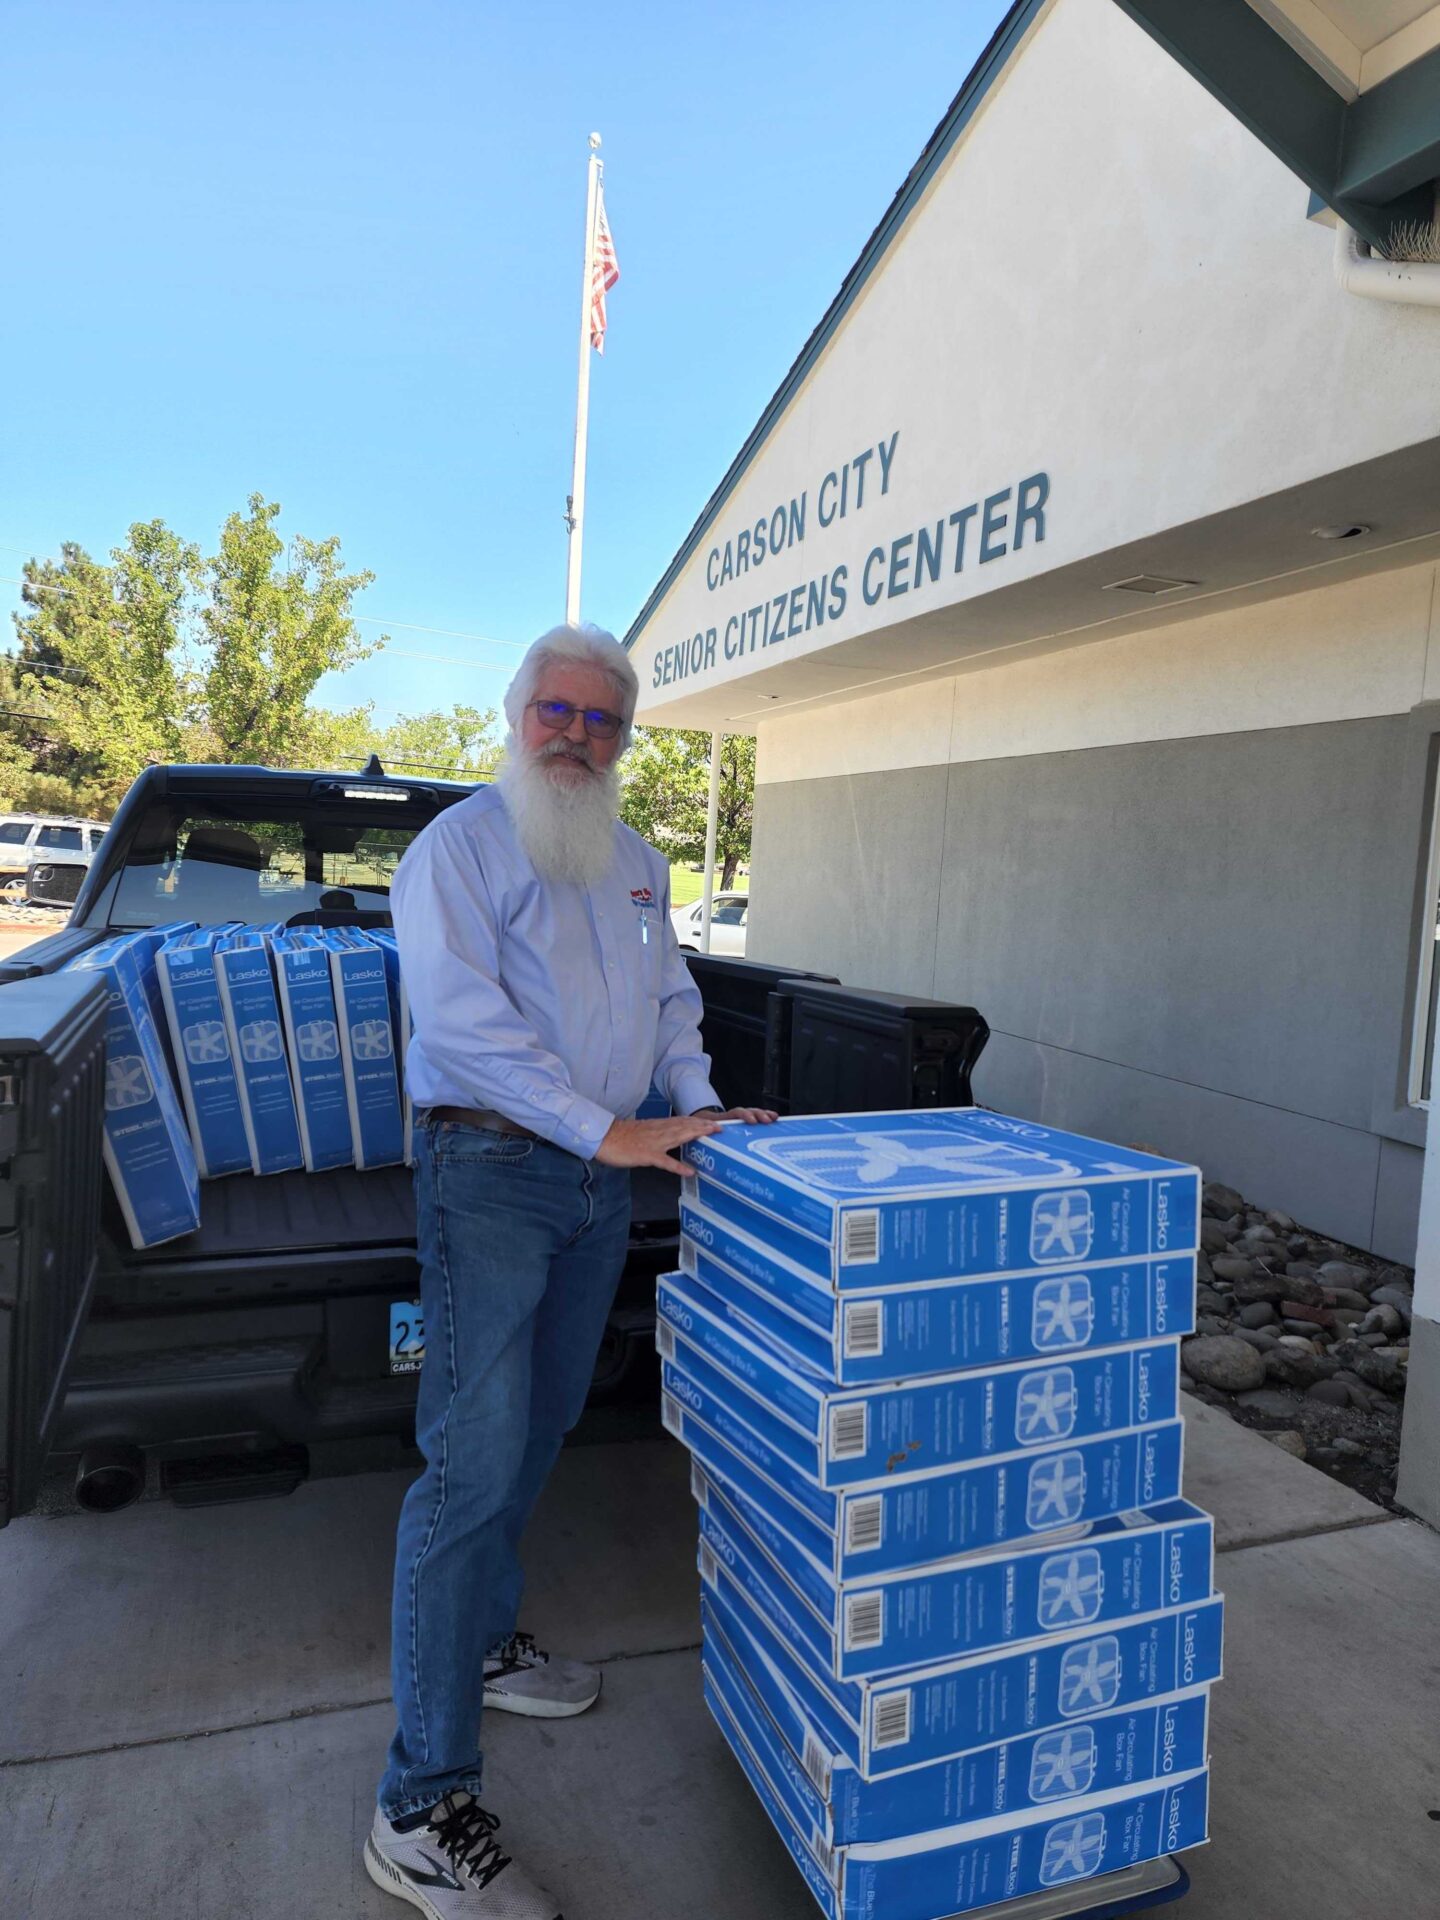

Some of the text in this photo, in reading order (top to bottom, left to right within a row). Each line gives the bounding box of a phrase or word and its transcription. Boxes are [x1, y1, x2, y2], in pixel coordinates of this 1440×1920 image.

[706, 431, 900, 591] CARSON CITY
[652, 471, 1051, 689] SENIOR CITIZENS CENTER
[171, 967, 214, 982] Lasko
[229, 968, 269, 981] Lasko
[288, 968, 328, 982] Lasko
[344, 969, 383, 981] Lasko
[953, 1111, 1050, 1139] Lasko
[685, 1141, 715, 1171] Lasko
[683, 1210, 714, 1246] Lasko
[1000, 1199, 1008, 1238] STEEL
[1156, 1182, 1170, 1249] Lasko
[660, 1290, 693, 1331] Lasko
[1155, 1265, 1168, 1333] Lasko
[666, 1366, 702, 1411] Lasko
[1138, 1352, 1151, 1421] Lasko
[1143, 1433, 1158, 1501] Lasko
[702, 1512, 736, 1566] Lasko
[1170, 1533, 1184, 1602] Lasko
[1004, 1566, 1014, 1636] STEEL Body
[1183, 1614, 1197, 1683] Lasko
[1026, 1657, 1037, 1725] STEEL Body
[1128, 1718, 1136, 1730] Air
[1163, 1706, 1179, 1773] Lasko
[851, 1796, 860, 1818] Blue
[995, 1745, 1007, 1810] STEEL Body
[1130, 1802, 1146, 1862] Air Circulating
[1167, 1787, 1185, 1850] Lasko
[1006, 1835, 1021, 1896] STEEL Body
[866, 1890, 876, 1911] Blue
